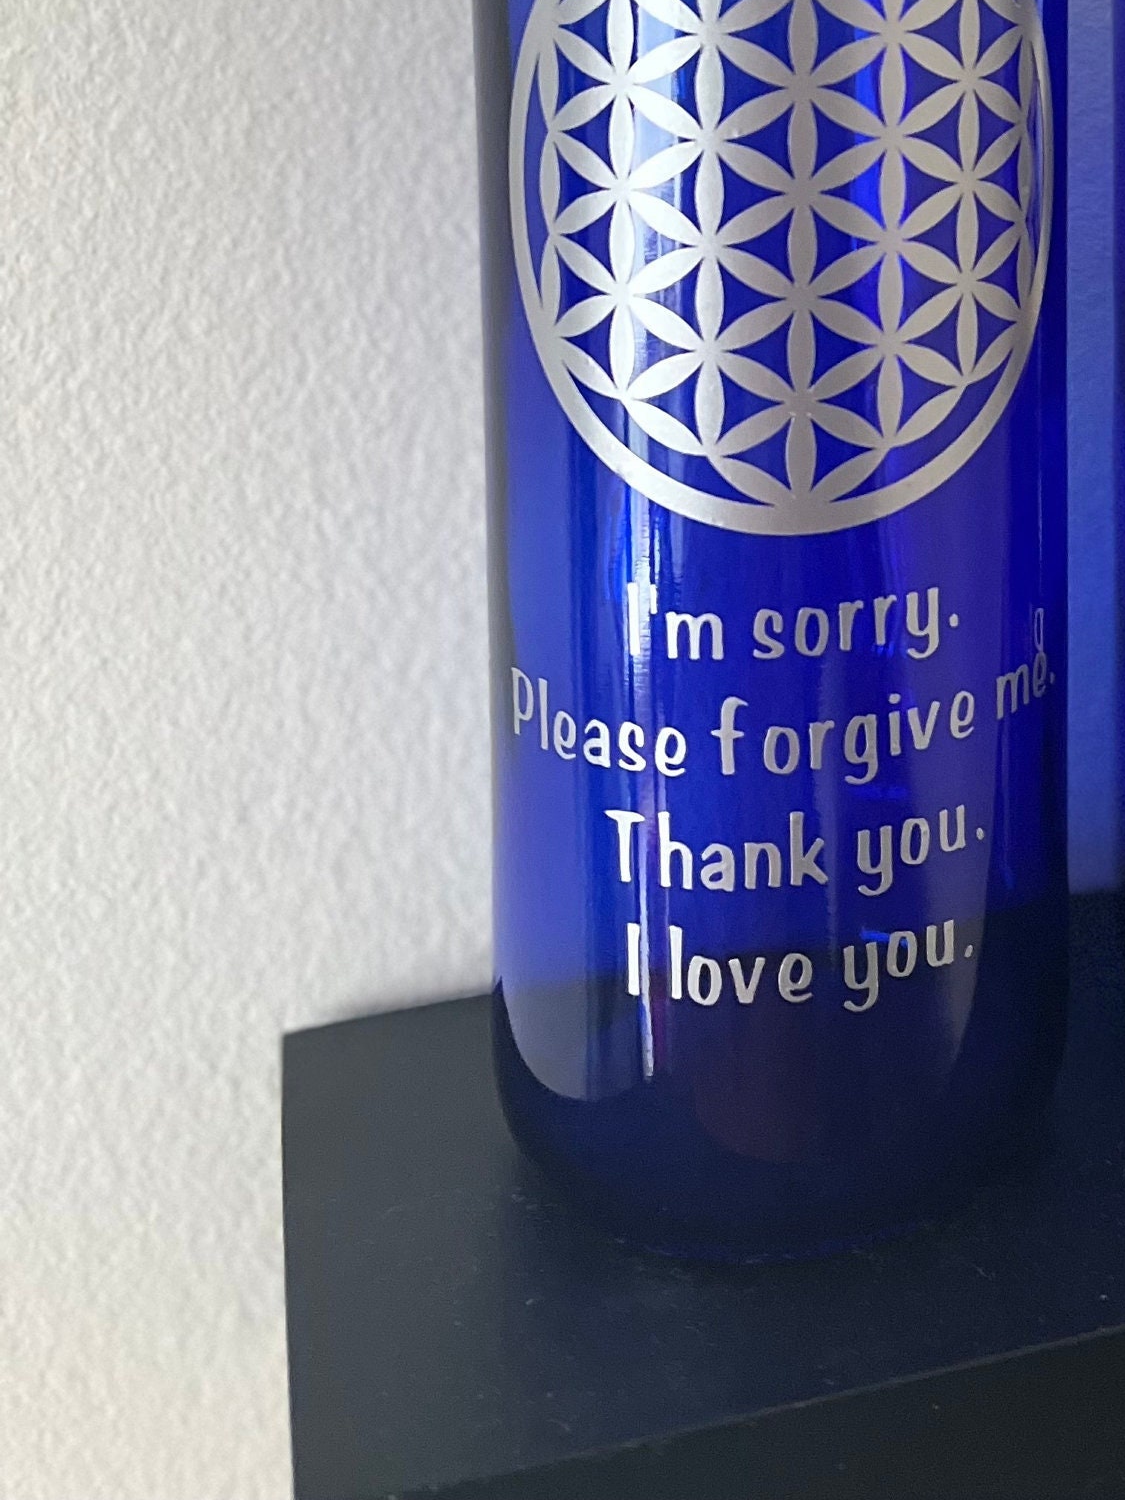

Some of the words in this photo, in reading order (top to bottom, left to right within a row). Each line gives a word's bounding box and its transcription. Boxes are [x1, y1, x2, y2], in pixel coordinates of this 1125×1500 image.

[626, 581, 725, 661] I'm
[752, 585, 960, 661] sorry.
[510, 665, 687, 777] Please
[710, 689, 976, 786] forgive
[995, 651, 1056, 720] me.
[603, 808, 829, 893] Thank
[856, 803, 986, 897] you.
[626, 922, 641, 997] I
[667, 924, 814, 1007] love
[842, 919, 975, 1013] you.
